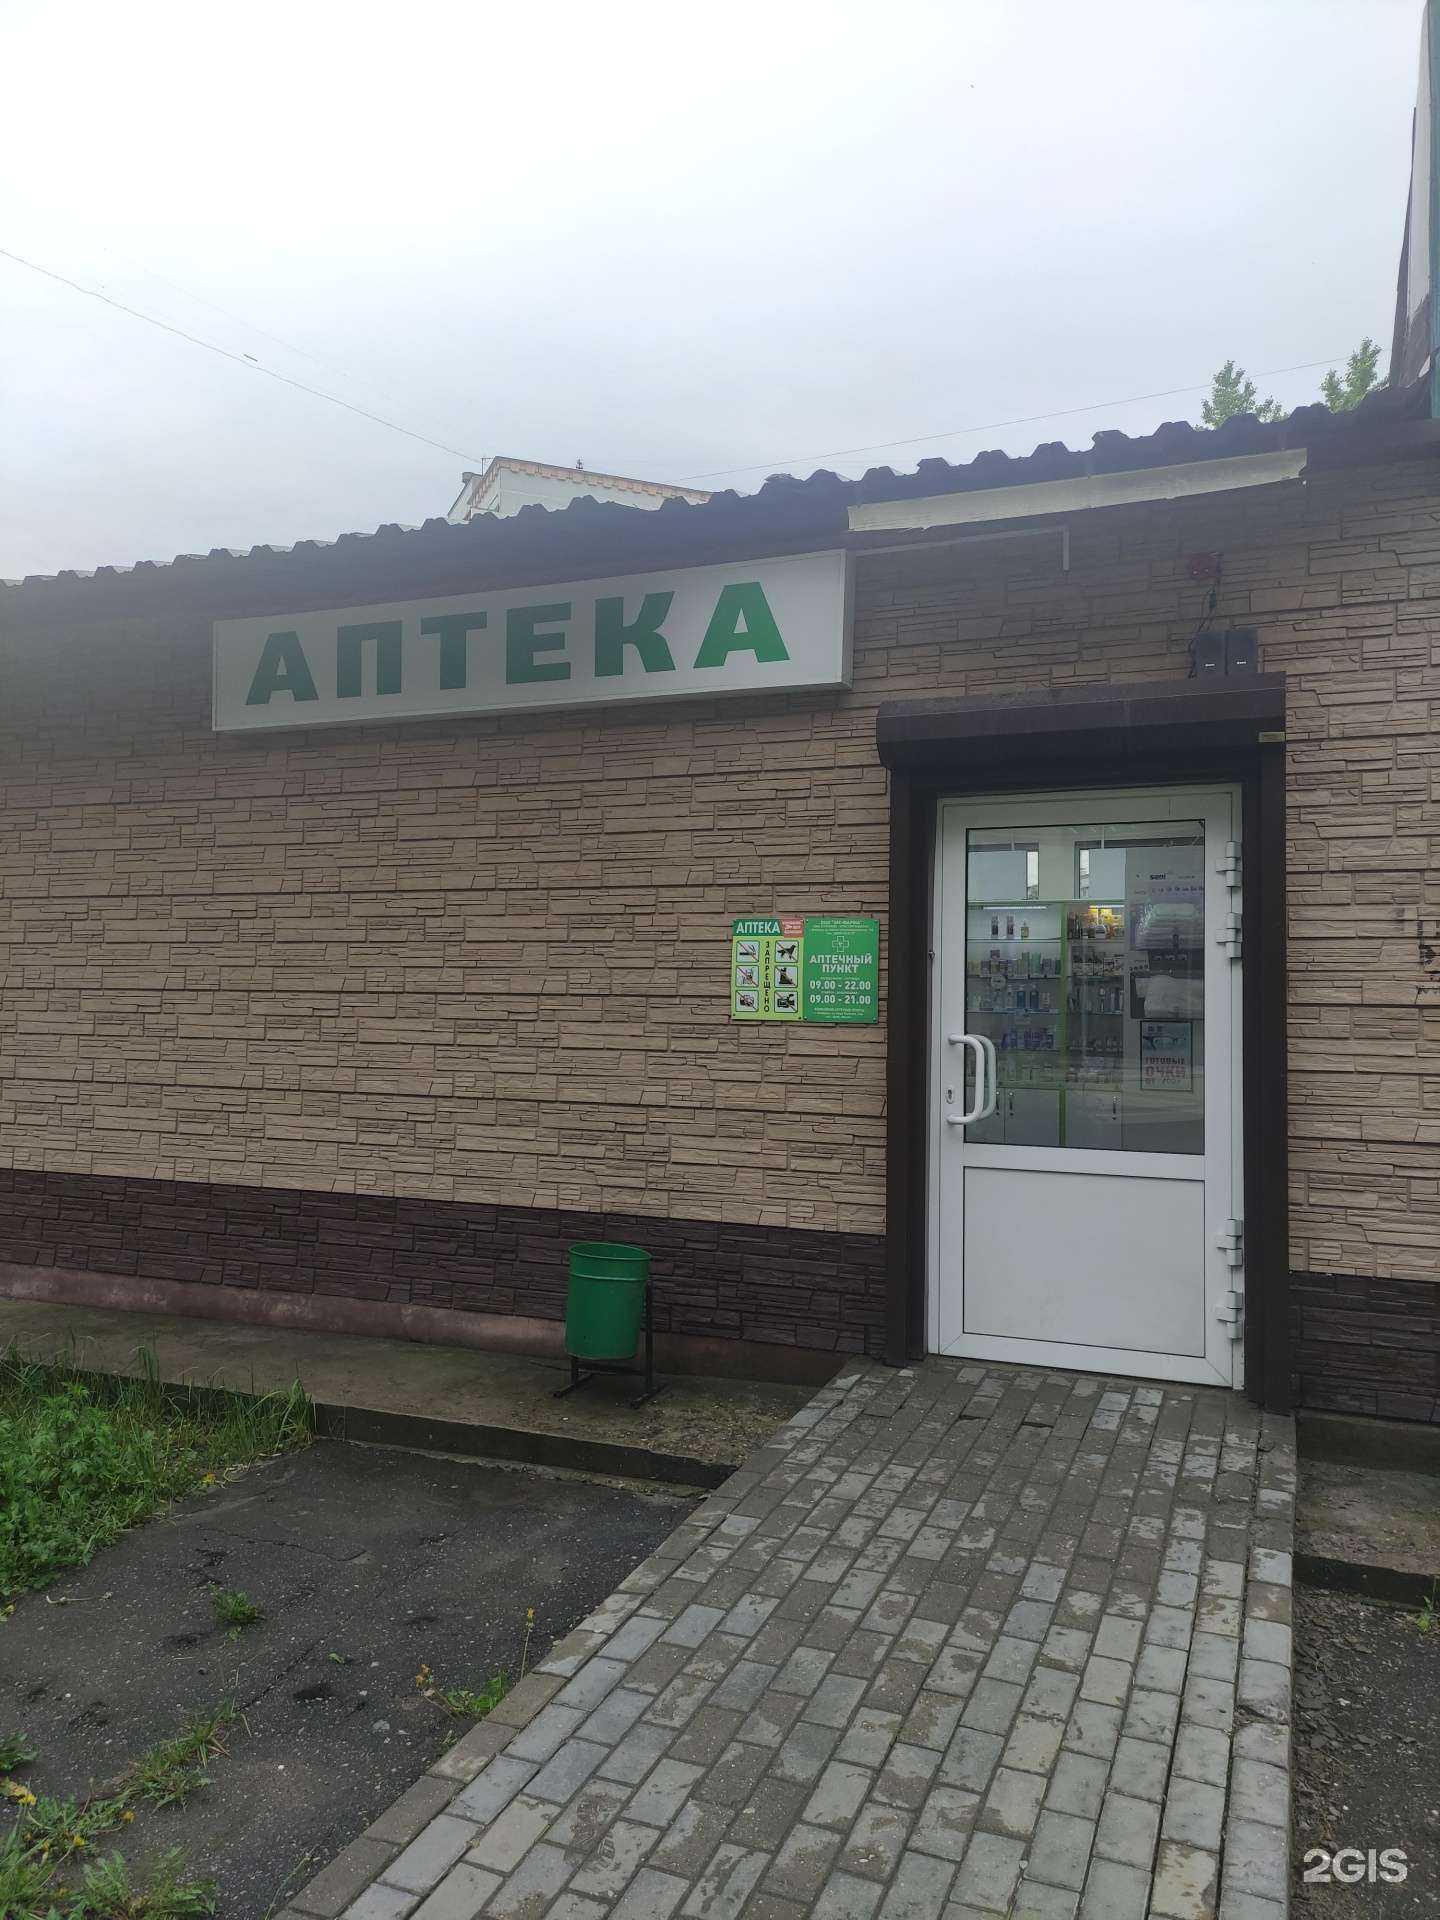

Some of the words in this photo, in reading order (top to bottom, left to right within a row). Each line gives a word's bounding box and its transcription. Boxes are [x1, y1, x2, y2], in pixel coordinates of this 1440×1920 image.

[245, 581, 790, 706] АПТЕКА
[736, 921, 780, 934] АПТЕКА
[809, 953, 872, 964] АПТЕЧНЫЙ
[822, 964, 859, 973] ПУНКТ
[810, 980, 836, 990] 09.00
[845, 981, 871, 990] 22.00
[810, 994, 836, 1004] 09.00
[845, 995, 871, 1005] 21.00
